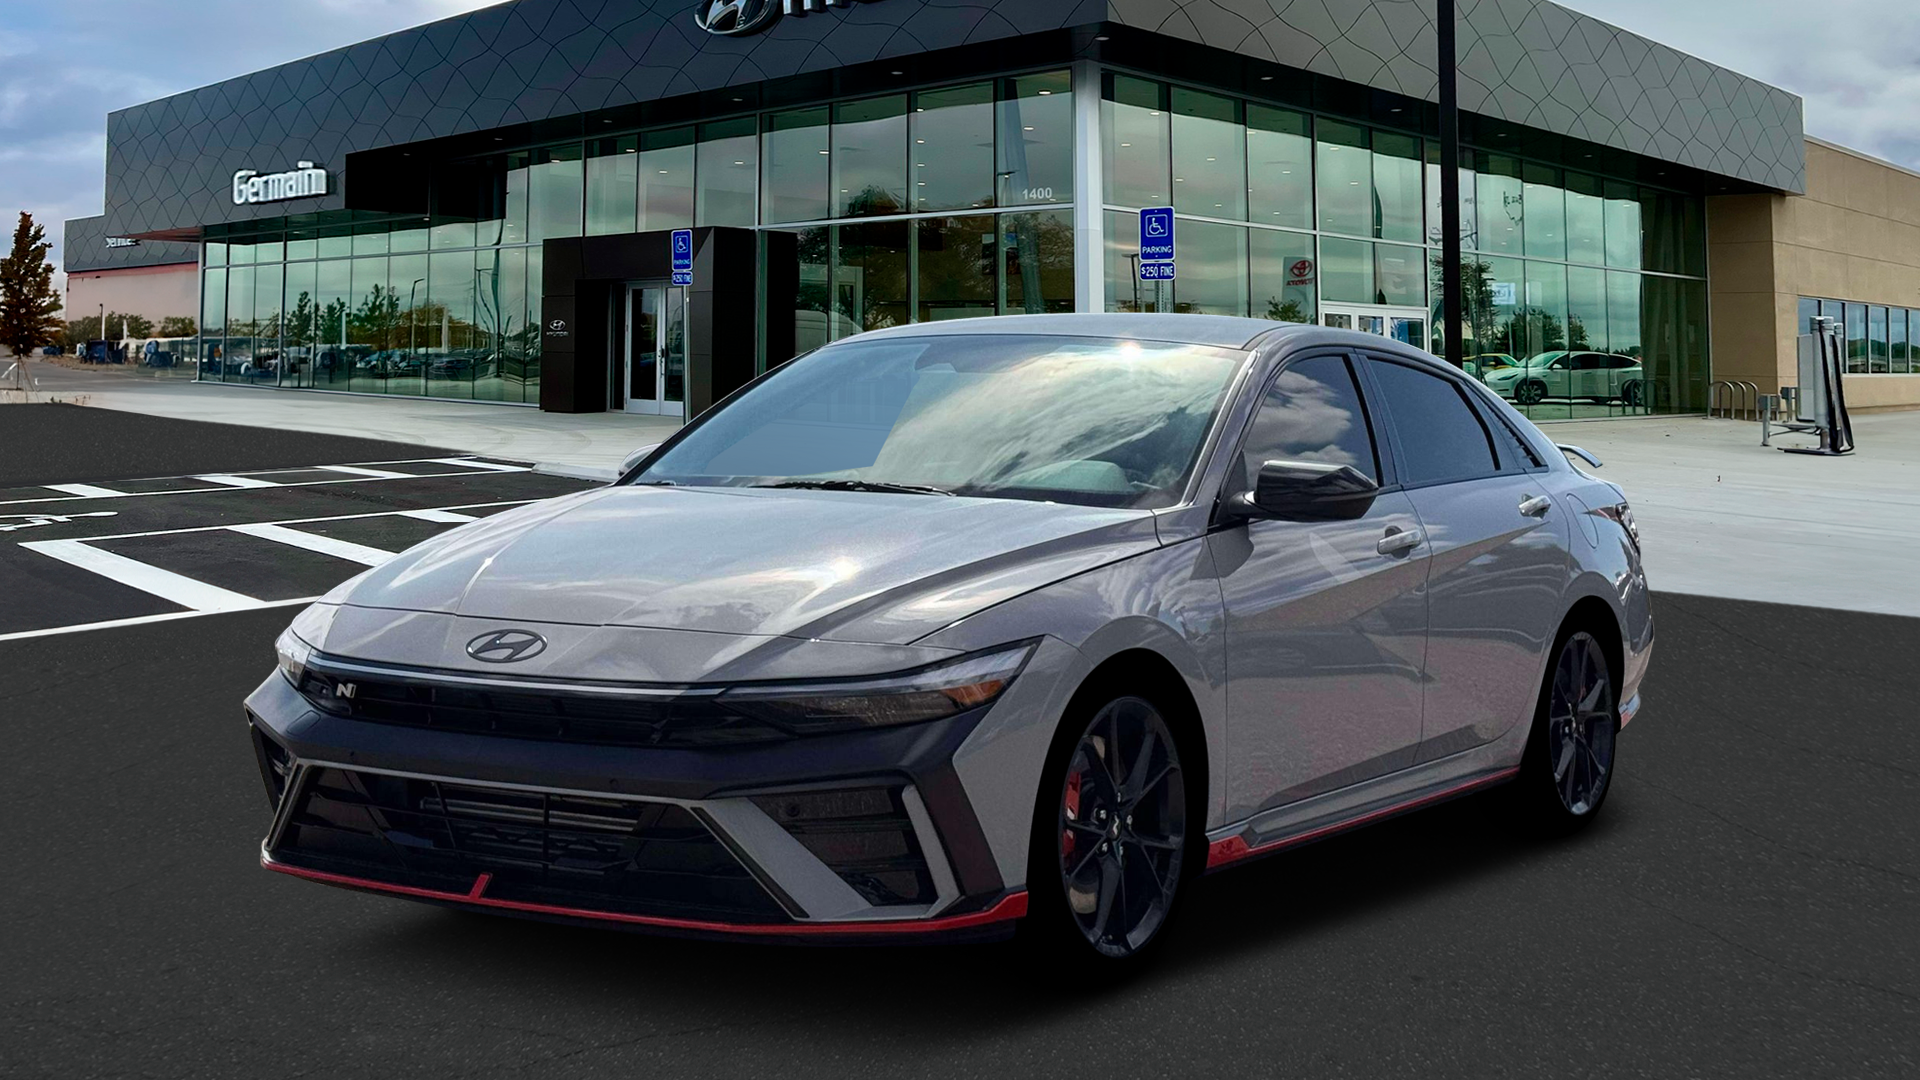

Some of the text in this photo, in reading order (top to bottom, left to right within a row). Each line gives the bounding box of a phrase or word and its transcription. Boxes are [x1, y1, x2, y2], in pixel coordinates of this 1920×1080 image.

[233, 161, 327, 205] Germain
[1022, 187, 1053, 200] 1400
[1142, 246, 1172, 254] PARKING
[1141, 266, 1174, 278] $250 FINE
[336, 683, 357, 699] N
